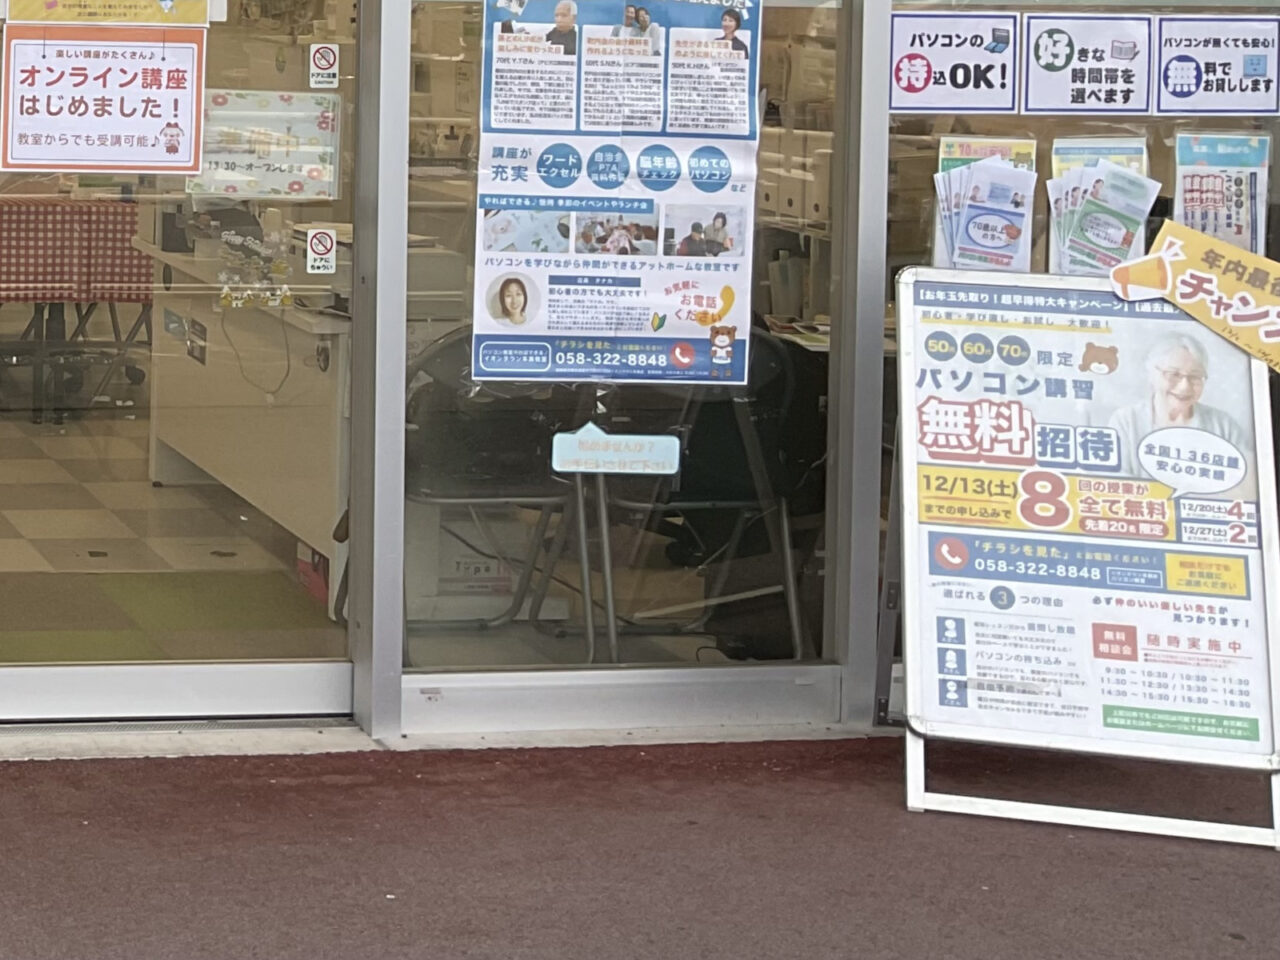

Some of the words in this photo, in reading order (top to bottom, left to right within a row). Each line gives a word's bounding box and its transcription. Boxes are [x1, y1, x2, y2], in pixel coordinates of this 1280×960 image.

[910, 33, 984, 48] パソコンの
[19, 65, 188, 90] オンライン講座
[1070, 67, 1136, 85] 時間帯を
[1203, 78, 1273, 93] お貸しします
[1070, 88, 1135, 104] 選べます
[492, 146, 531, 159] 講座が
[542, 154, 578, 166] ワード
[690, 158, 729, 168] 初めての
[491, 165, 528, 182] 充実
[539, 167, 579, 178] エクセル
[641, 170, 677, 178] チェック
[690, 170, 730, 180] パソコン
[731, 184, 746, 192] など
[680, 294, 717, 309] お電話
[555, 352, 668, 366] 058-322-8848
[1037, 350, 1073, 367] 限定
[915, 368, 1094, 400] パソコン講習
[1078, 479, 1148, 495] 回の授業が
[1020, 471, 1070, 528] 8
[924, 504, 1012, 520] までの申し込みで
[1079, 496, 1167, 520] 全て無料
[975, 558, 1101, 580] 058-322-8848
[1104, 631, 1126, 641] 無料
[1099, 643, 1132, 655] 相談会
